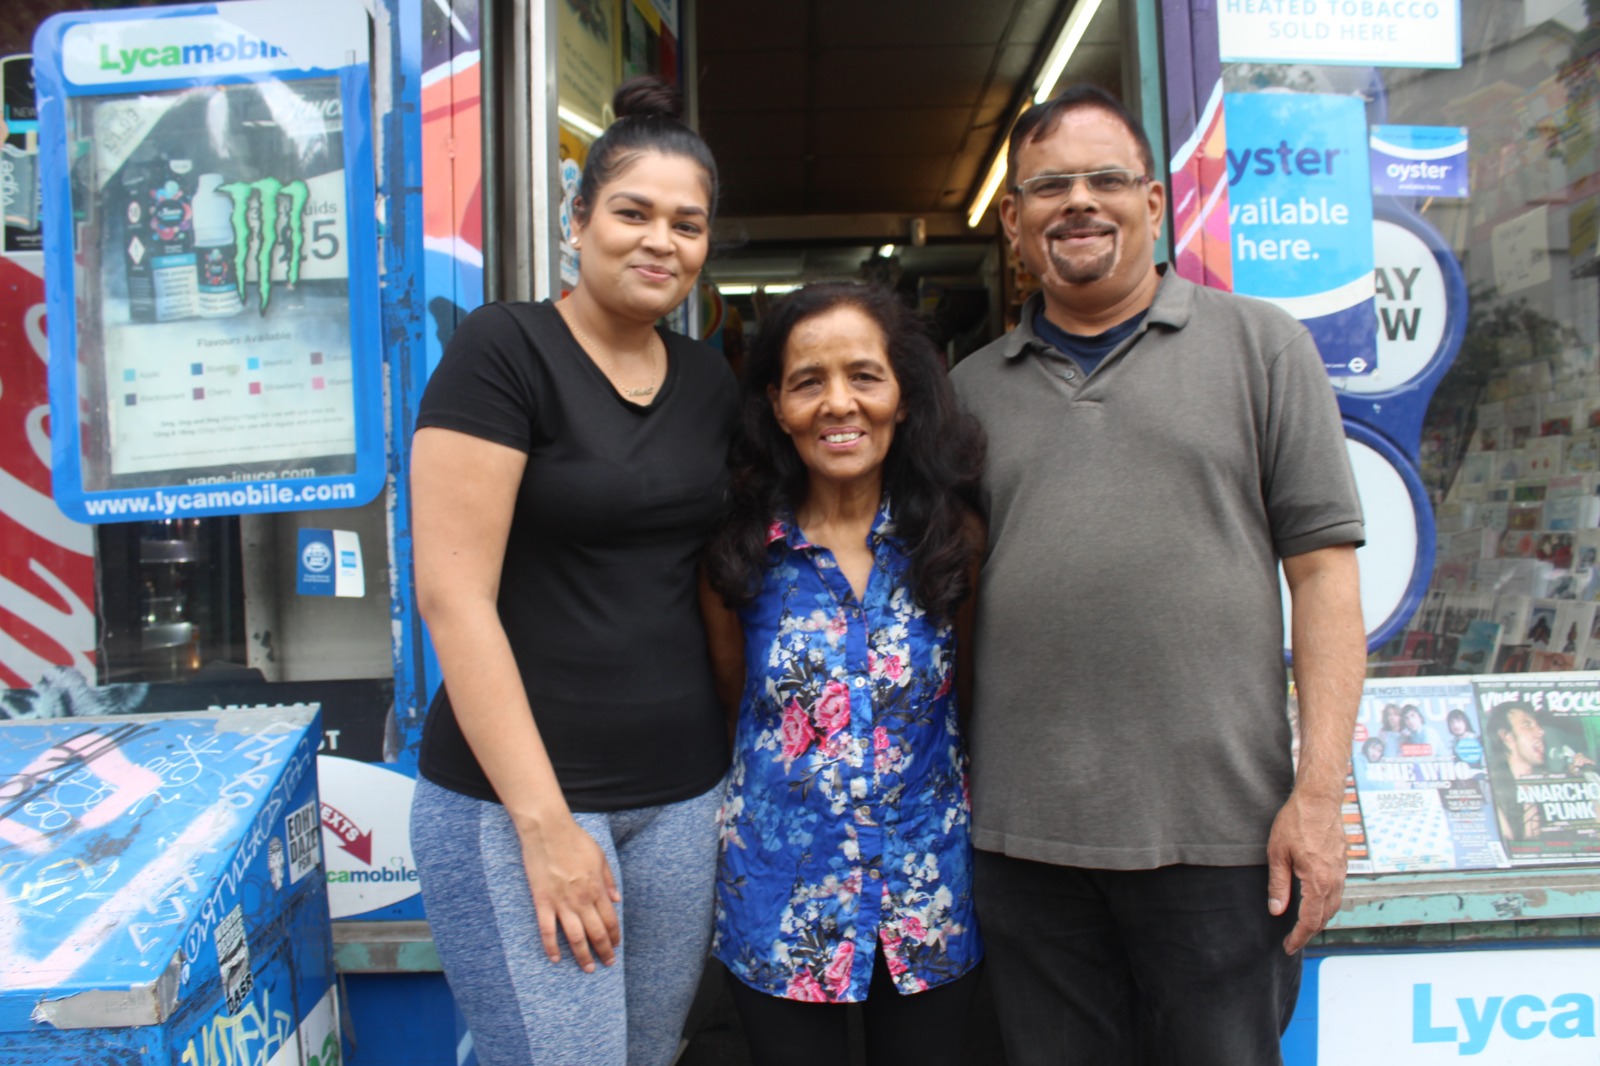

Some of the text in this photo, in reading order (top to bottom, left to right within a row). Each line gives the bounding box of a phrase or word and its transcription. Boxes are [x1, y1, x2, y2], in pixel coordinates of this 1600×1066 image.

[1227, 0, 1440, 19] HEATED TOBACCO
[1269, 20, 1399, 42] SOLD HERE
[1386, 161, 1448, 182] oyster
[1237, 233, 1320, 261] here.
[84, 482, 356, 516] www.lycamobile.com
[1516, 782, 1600, 804] ANARCHO
[1543, 800, 1597, 822] PUNK
[320, 803, 360, 842] EXTS
